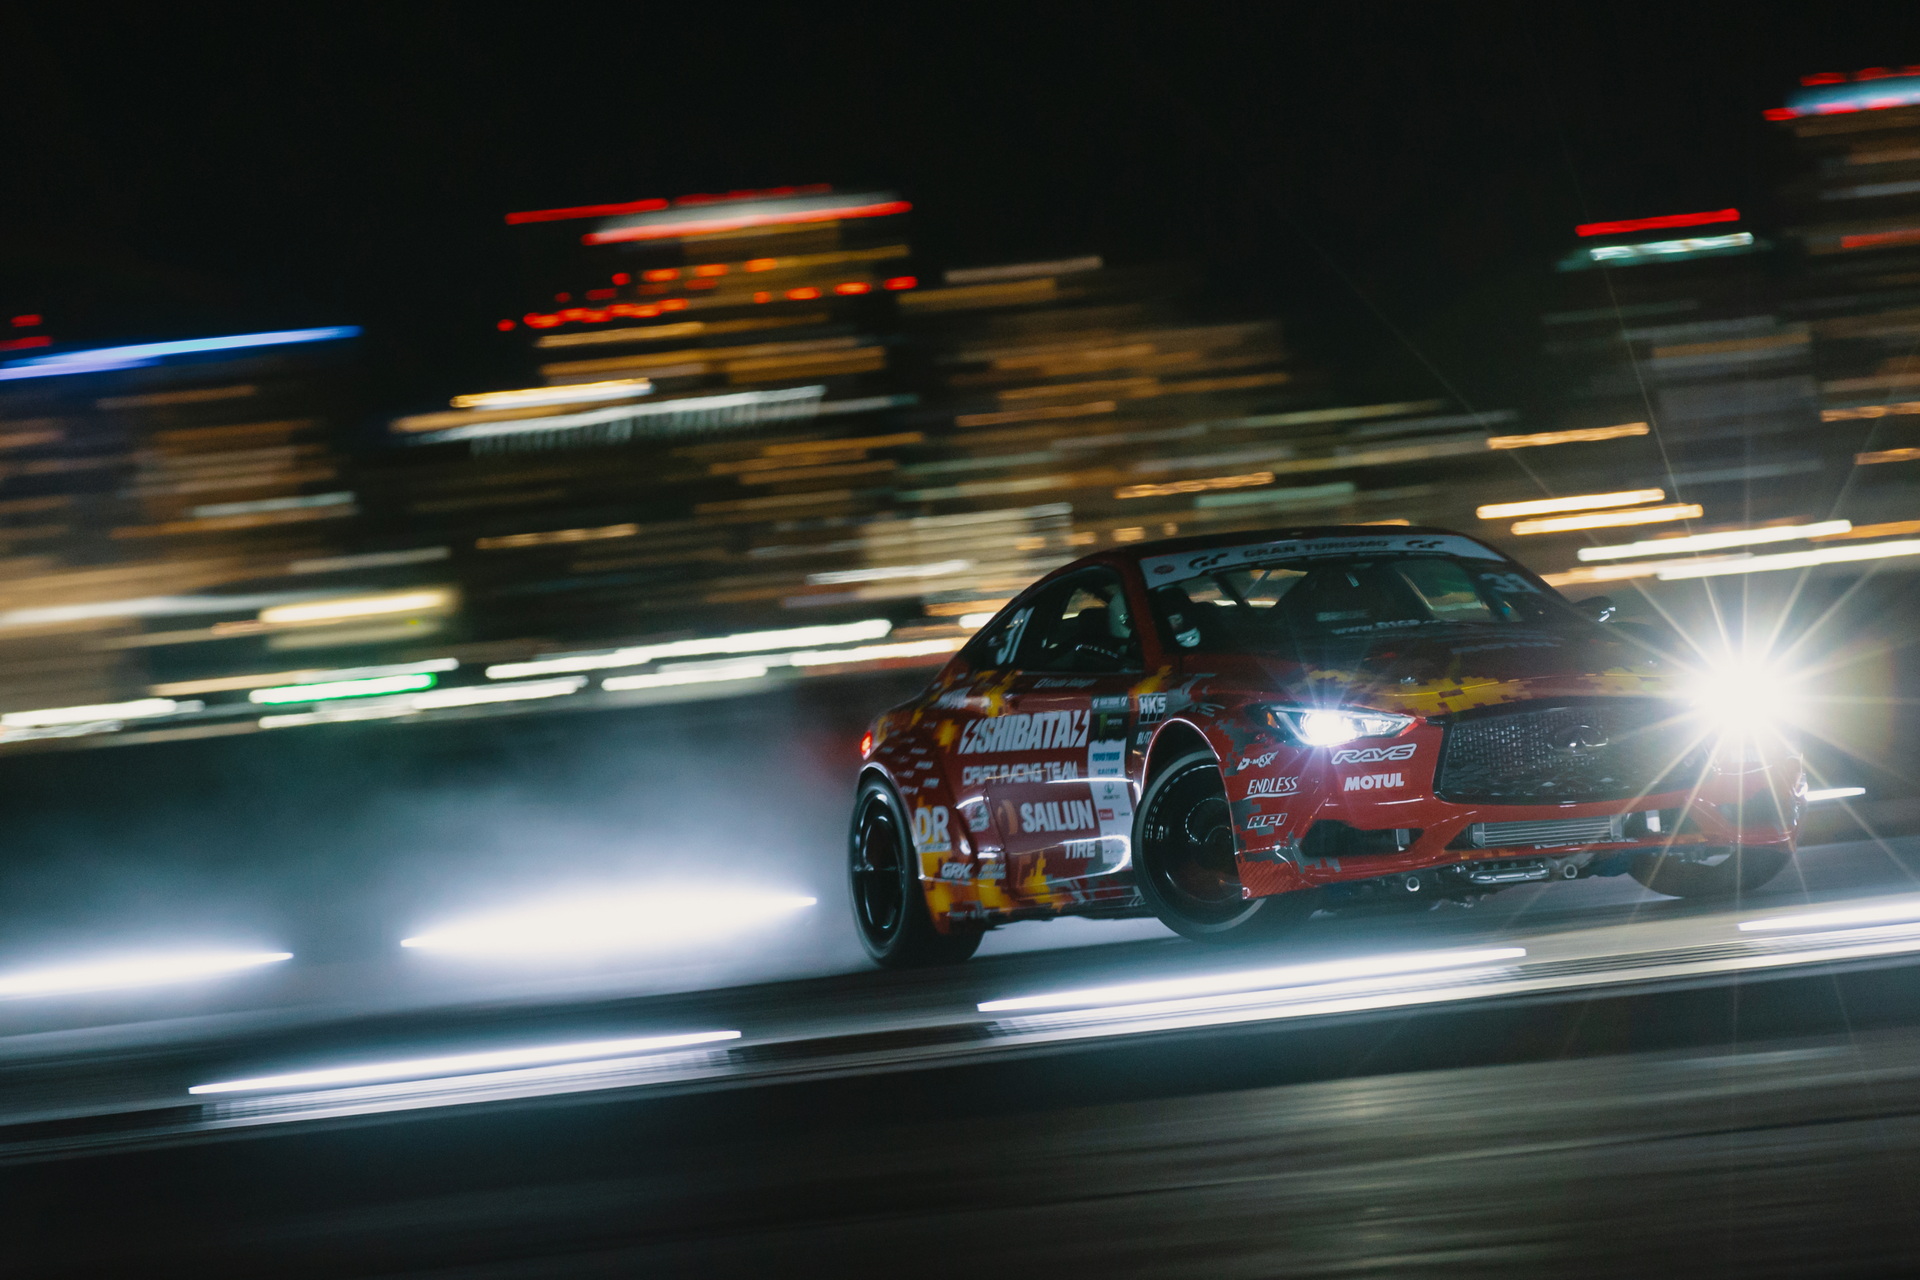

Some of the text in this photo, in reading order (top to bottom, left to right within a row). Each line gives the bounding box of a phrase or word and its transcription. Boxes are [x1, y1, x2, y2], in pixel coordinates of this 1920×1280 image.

[1244, 546, 1296, 558] GRAN
[1304, 540, 1390, 551] TURISMO
[1139, 694, 1166, 715] HKS
[973, 710, 1073, 754] SHIBATA
[1331, 743, 1417, 765] RAYS
[962, 765, 999, 785] DRIFT
[1043, 760, 1079, 782] TEAM
[1344, 773, 1404, 791] MOTUL
[1247, 776, 1299, 795] ENDLESS
[915, 805, 951, 844] DR
[1020, 800, 1095, 833] SAILUN
[1247, 813, 1288, 829] HPI
[1065, 841, 1096, 859] TIRE
[941, 862, 974, 880] GRK
